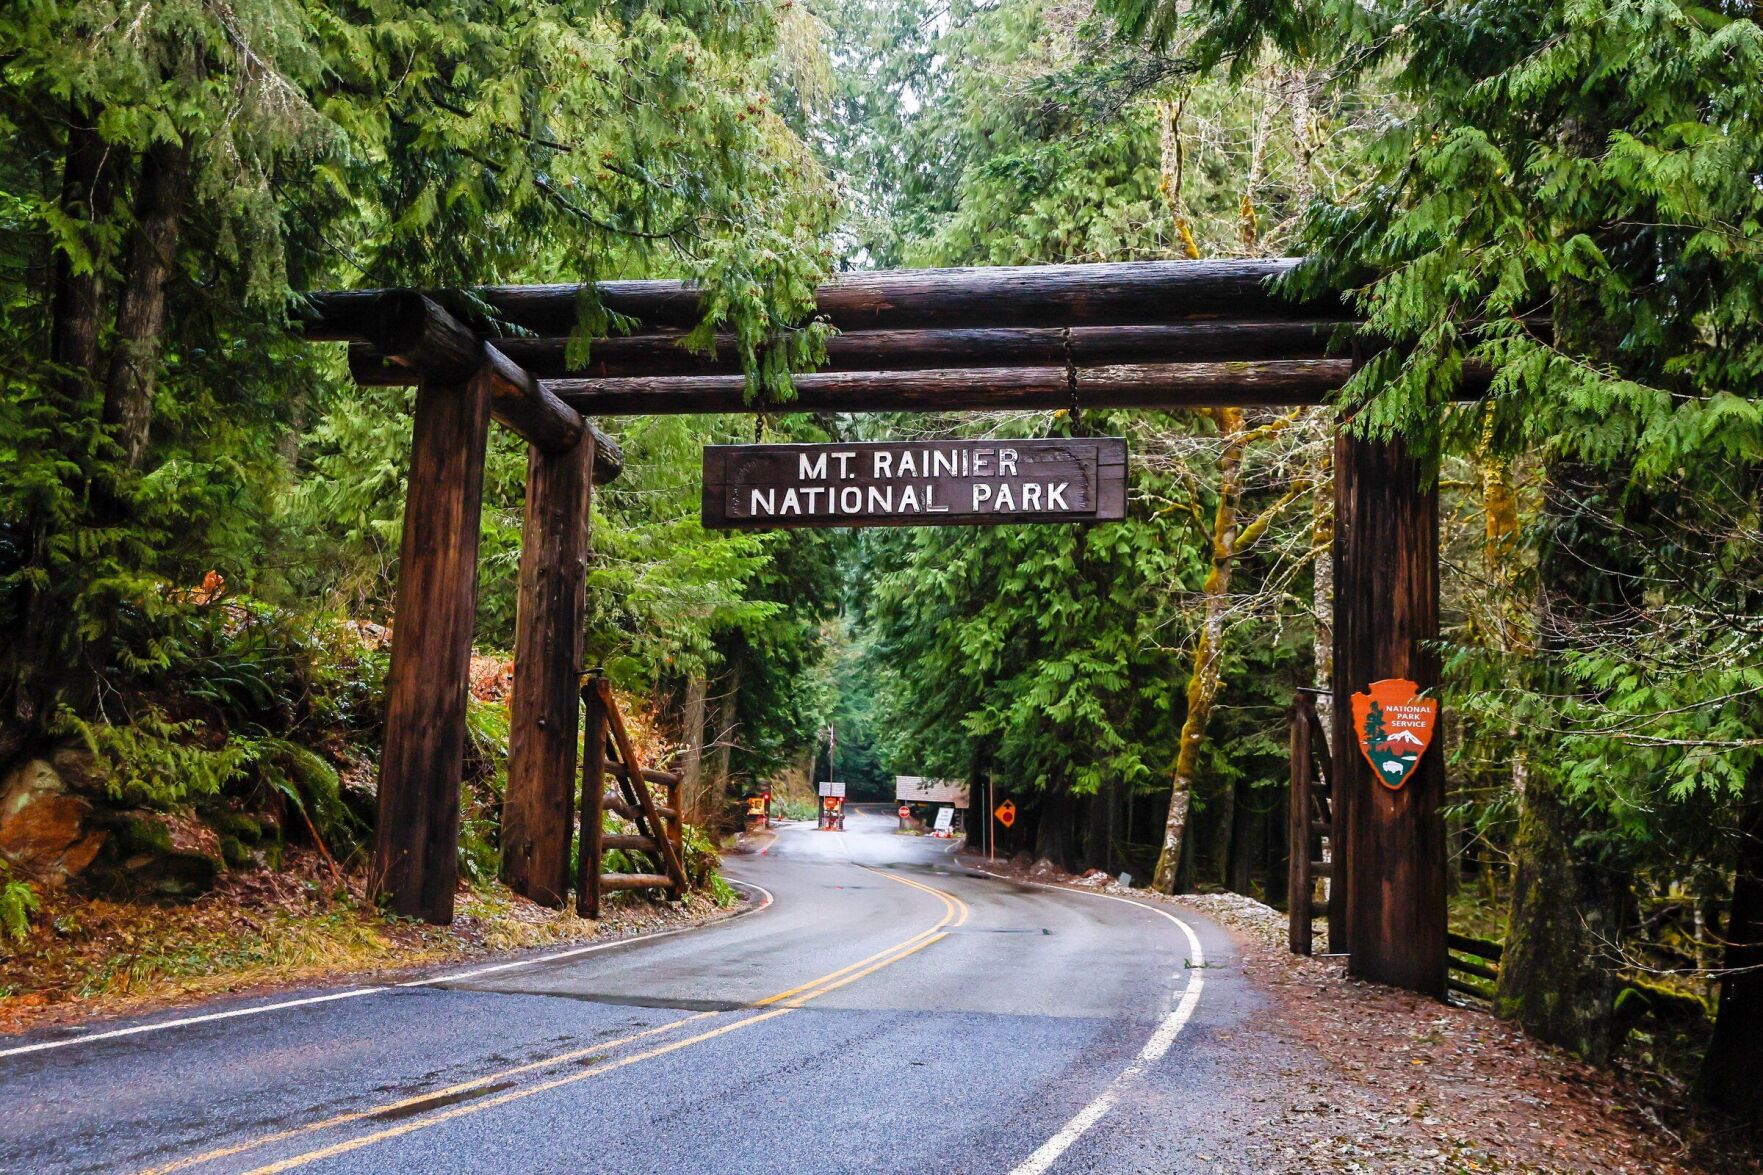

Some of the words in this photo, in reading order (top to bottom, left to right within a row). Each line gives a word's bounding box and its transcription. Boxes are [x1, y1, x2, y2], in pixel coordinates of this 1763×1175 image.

[799, 451, 857, 480] MT.
[873, 448, 1018, 479] RAINIER
[750, 484, 949, 516] NATIONAL
[972, 481, 1070, 512] PARK
[1386, 705, 1431, 713] NATIONAL
[1391, 720, 1426, 728] SERVICE
